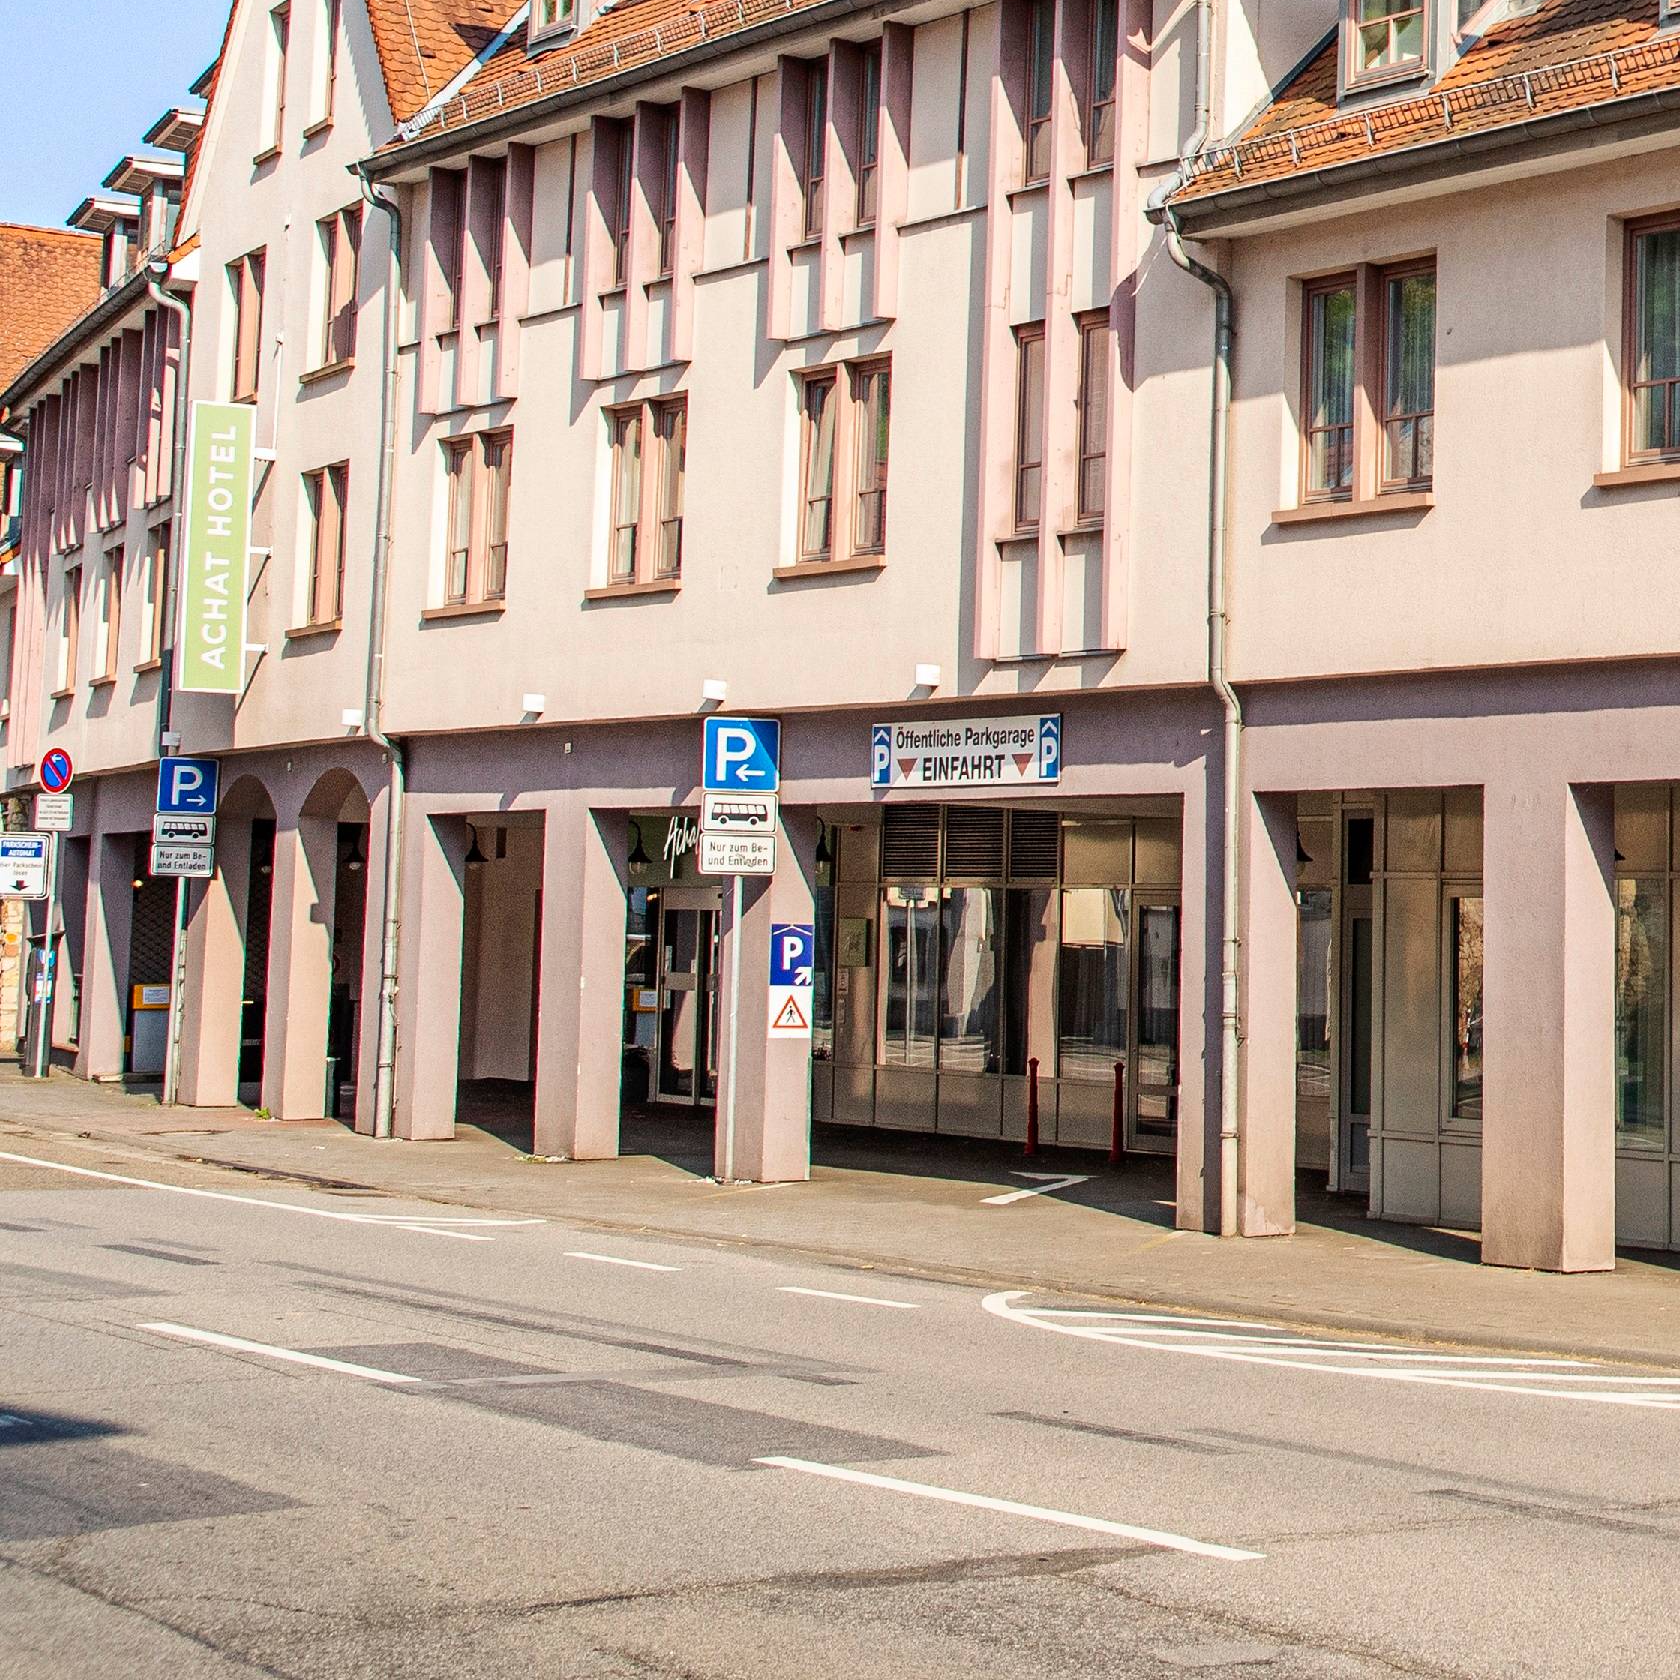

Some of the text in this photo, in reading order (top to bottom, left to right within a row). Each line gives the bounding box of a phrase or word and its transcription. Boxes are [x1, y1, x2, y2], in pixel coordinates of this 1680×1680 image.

[200, 425, 237, 670] ACHAT HOTEL
[715, 727, 757, 782] P
[896, 726, 1035, 750] Öffentliche Parkgarage
[873, 744, 890, 782] P
[922, 754, 1006, 782] EINFAHRT
[1040, 736, 1058, 777] P
[171, 765, 203, 806] P
[708, 855, 725, 866] und
[710, 841, 768, 853] Nur zum Be-
[782, 936, 804, 971] P
